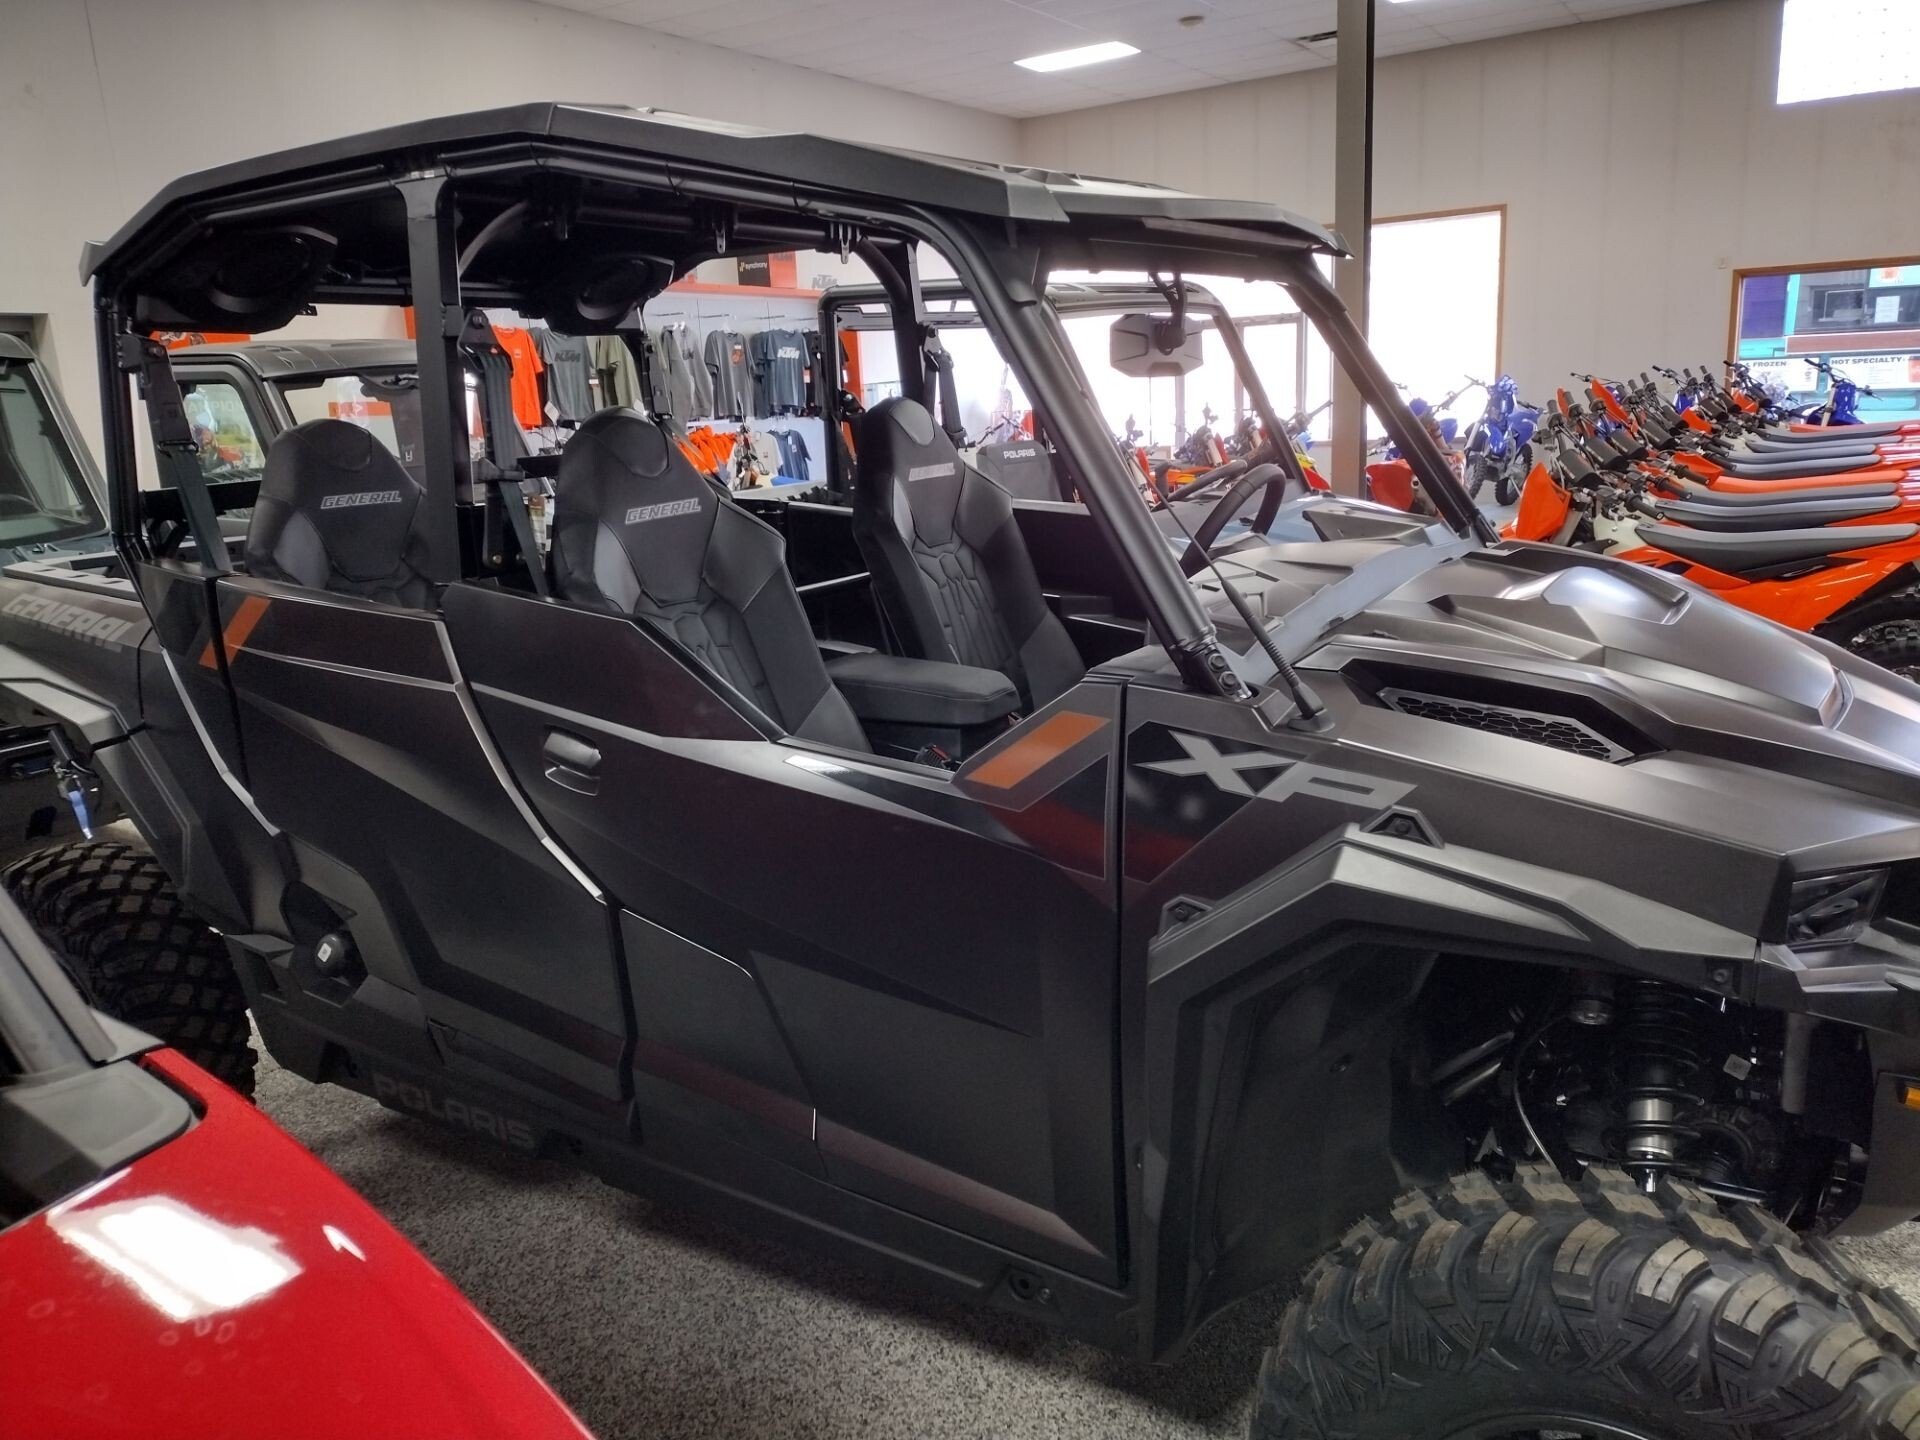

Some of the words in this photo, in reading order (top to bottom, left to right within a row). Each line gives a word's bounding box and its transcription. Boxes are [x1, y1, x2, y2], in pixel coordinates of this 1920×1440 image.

[554, 350, 581, 362] KTM
[777, 346, 800, 359] KTM
[1004, 448, 1036, 459] POLARIS
[321, 490, 402, 509] GENERAL
[625, 497, 702, 525] GENERAL
[1, 593, 135, 653] GENERAL
[1133, 729, 1418, 810] XP
[373, 1073, 536, 1150] POLARIS
